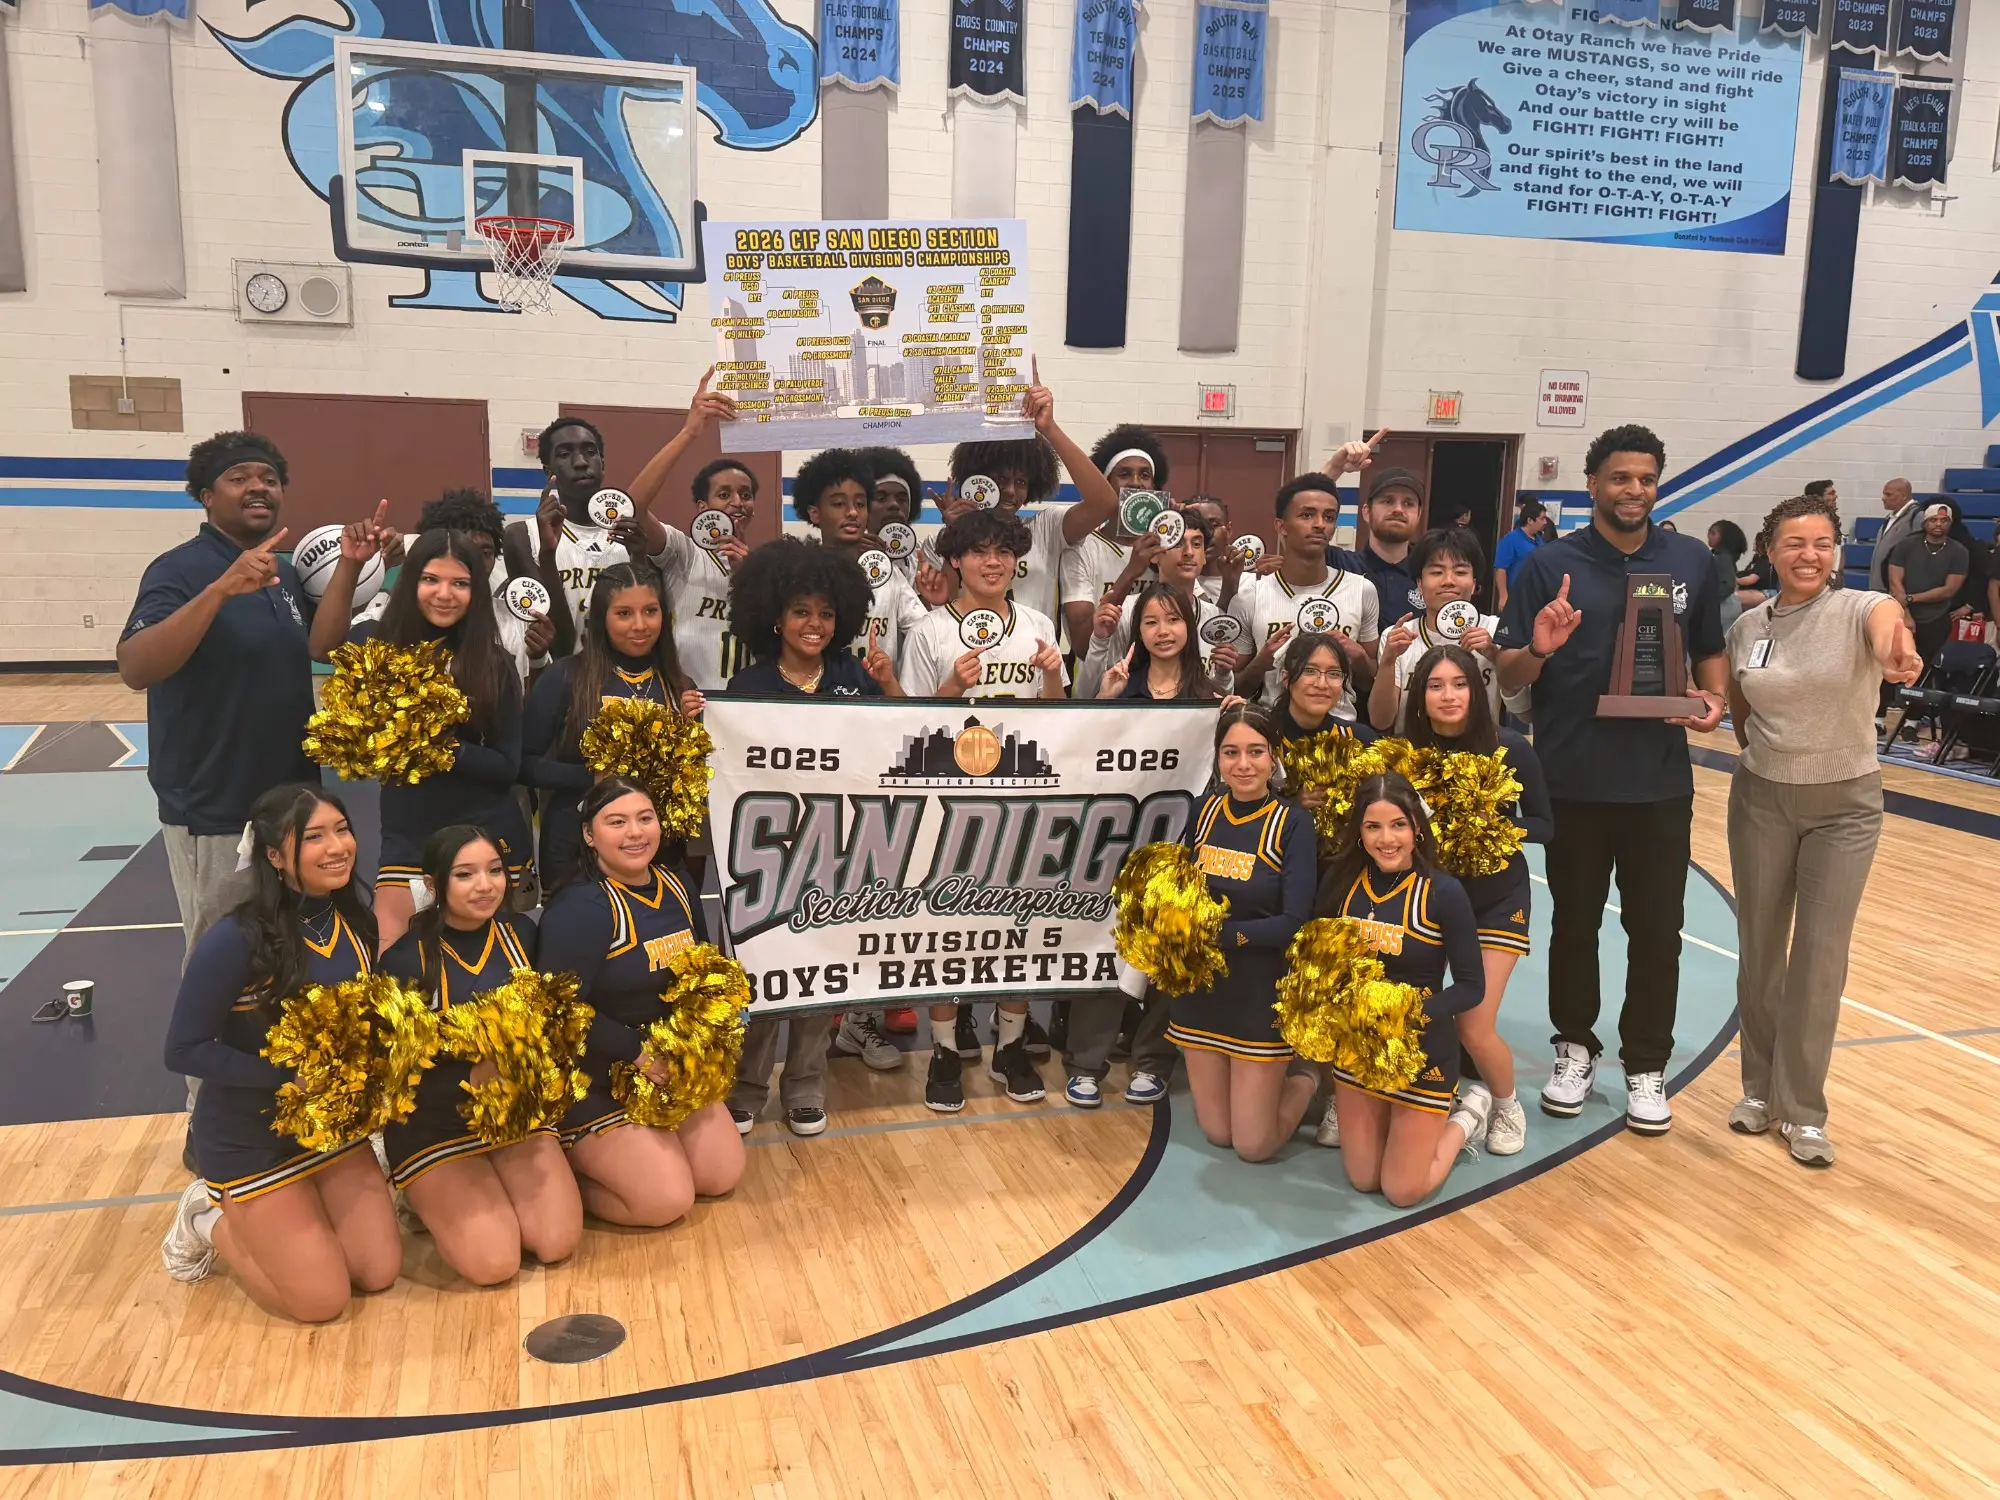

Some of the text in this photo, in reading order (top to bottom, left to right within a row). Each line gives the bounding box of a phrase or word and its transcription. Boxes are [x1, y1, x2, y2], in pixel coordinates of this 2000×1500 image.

[826, 3, 892, 21] FLAG FOOTBALL
[1083, 1, 1134, 28] SOUTH BAY
[1776, 8, 1806, 22] 2022
[1910, 8, 1946, 23] CHAMPS
[834, 25, 884, 41] CHAMPS
[955, 14, 1018, 36] CROSS COUNTRY
[1205, 14, 1259, 42] SOUTH BAY
[1848, 19, 1874, 32] 2023
[1914, 26, 1938, 39] 2023
[963, 36, 1010, 55] CHAMPS
[1090, 31, 1126, 50] TENNIS
[1505, 25, 1761, 63] At Otay Ranch we have Pride
[842, 46, 877, 62] 2024
[1203, 43, 1257, 62] BASKETBALL
[969, 58, 1004, 74] 2024
[1478, 40, 1783, 83] We are MUSTANGS, so we will ride
[1208, 64, 1251, 80] CHAMPS
[1503, 62, 1754, 99] Give a cheer, stand and fight
[1212, 84, 1246, 99] 2025
[1843, 87, 1869, 108] SOUTH
[1597, 89, 1658, 109] victory
[1663, 96, 1679, 108] in
[1684, 98, 1727, 114] sight
[1518, 100, 1739, 131] And our battle cry will be
[1533, 119, 1724, 148] FIGHT! FIGHT! FIGHT!
[1902, 137, 1938, 149] CHAMPS
[1508, 143, 1540, 157] Our
[1610, 151, 1648, 166] best
[1653, 155, 1669, 168] in
[1674, 157, 1702, 170] the
[1708, 160, 1743, 174] land
[1846, 148, 1871, 161] 2025
[1907, 154, 1933, 165] 2025
[1499, 163, 1742, 191] and fight to the end, we will
[1513, 181, 1733, 208] stand for O-T-A-Y, O-T-A-Y
[1527, 199, 1717, 224] FIGHT! FIGHT! FIGHT!
[736, 227, 998, 251] 2026 CIF SAN DIEGO SECTION
[1674, 232, 1699, 241] Donated
[767, 252, 847, 269] BASKETBALL
[850, 251, 903, 268] DIVISION
[905, 251, 914, 267] 5
[916, 250, 1010, 266] CHAMPIONSHIPS
[724, 272, 761, 281] #1 PREUSS
[980, 277, 1010, 286] ACADEMY
[741, 282, 759, 291] UCSD
[748, 293, 762, 302] BYE
[737, 330, 765, 339] HILLTOP
[797, 336, 851, 346] #1 PREUSS UCSD
[902, 332, 970, 343] #3 COASTAL ACADEMY
[813, 351, 852, 360] GROSSMONT
[716, 361, 766, 371] #5 PALO VERDE
[717, 381, 769, 390] HEALTH SCIENCES
[934, 375, 956, 384] VALLEY
[1548, 381, 1580, 391] NO EATING
[1543, 394, 1584, 403] OR DRINKING
[758, 414, 771, 423] BYE
[1548, 406, 1577, 415] ALLOWED
[863, 421, 901, 429] CHAMPION
[1638, 625, 1657, 634] CIF
[967, 632, 998, 646] CHAMPIONS
[746, 746, 1180, 772] 2025 2026
[956, 731, 997, 772] CIF
[880, 777, 1059, 786] SAN DIEGO SECTION
[726, 789, 1195, 945] SAN DIEGO
[1194, 844, 1256, 882] PREUSS
[790, 876, 1116, 933] Section Champions
[858, 926, 1063, 957] DIVISION 5
[878, 952, 1119, 991] BASKETBA
[67, 993, 83, 1009] G
[1422, 1073, 1445, 1081] adidas
